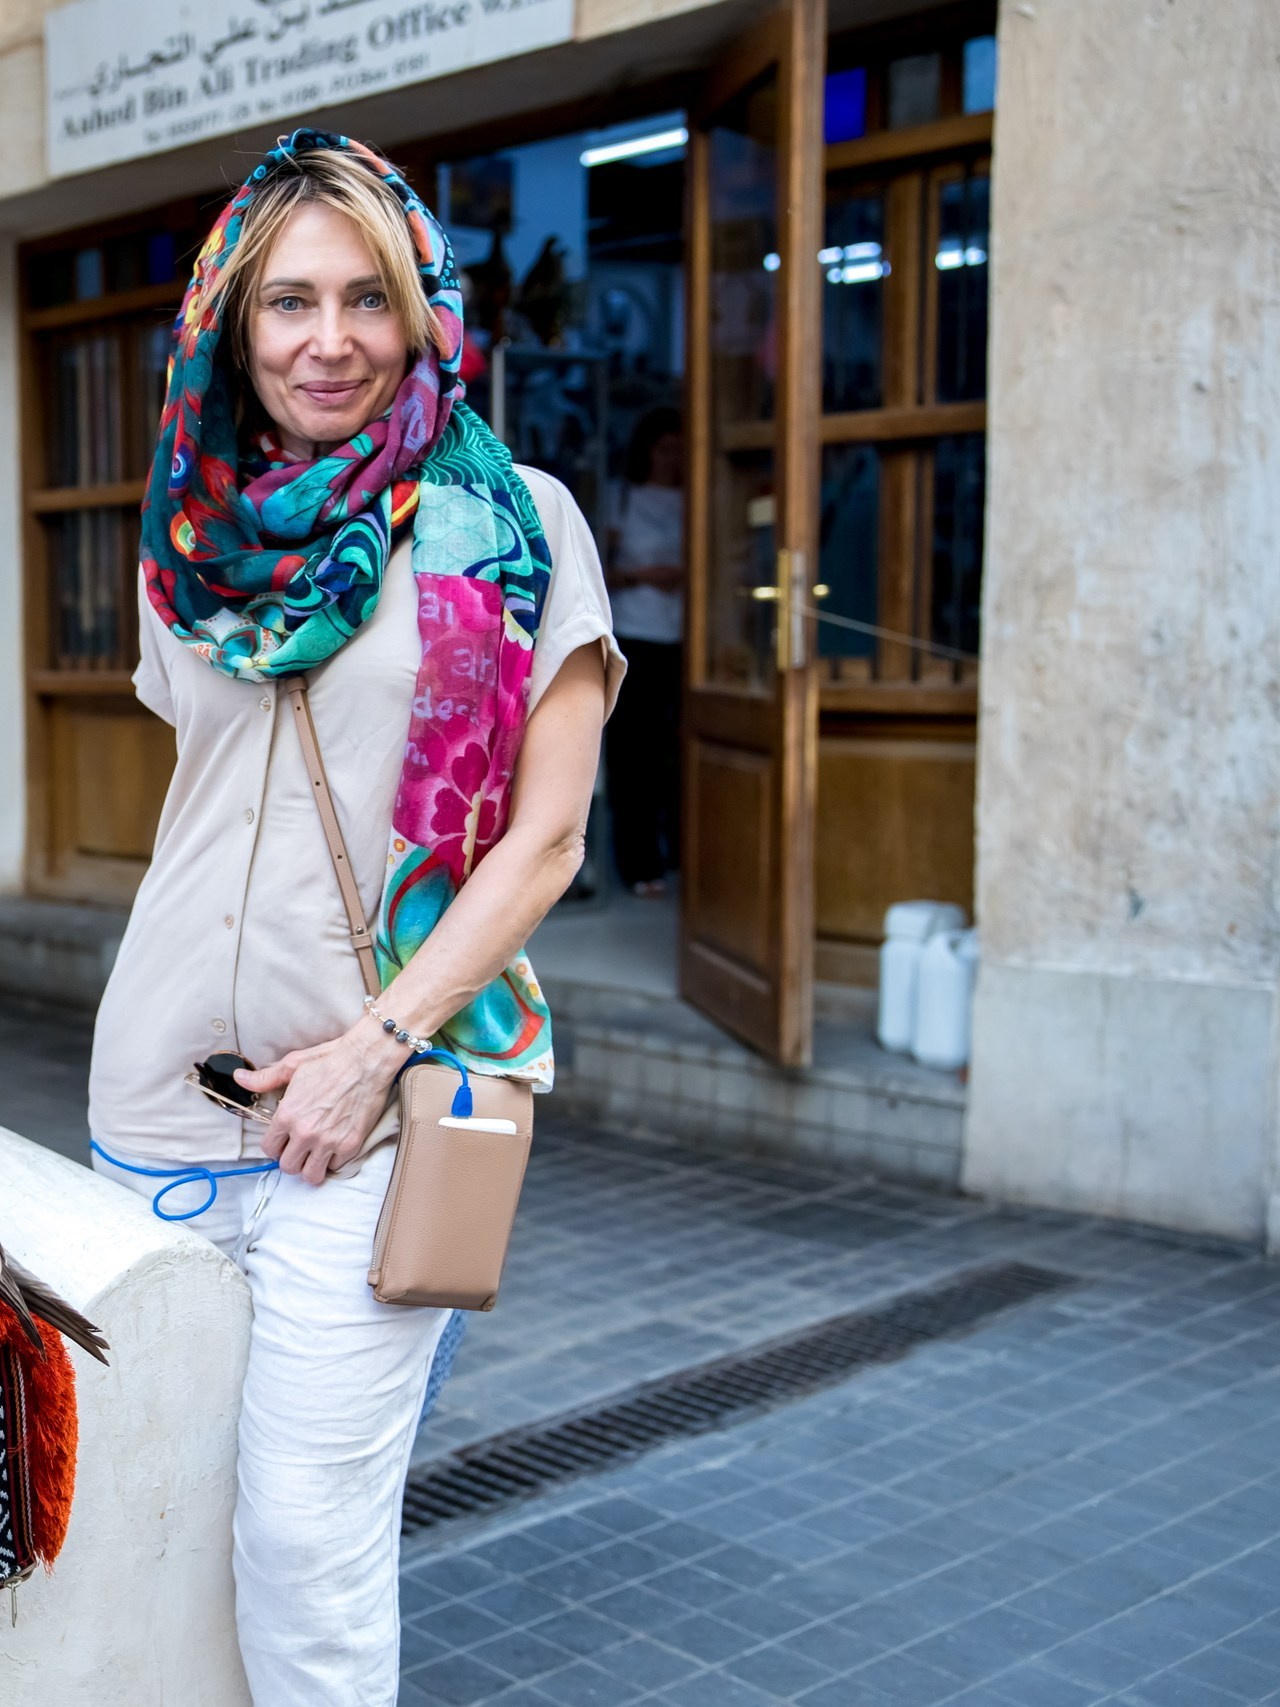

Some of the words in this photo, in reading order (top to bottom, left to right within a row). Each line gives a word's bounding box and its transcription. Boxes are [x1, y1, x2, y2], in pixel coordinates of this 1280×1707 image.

[142, 85, 188, 118] Bin
[193, 62, 235, 97] Ali
[244, 32, 359, 87] Trading
[367, 1, 471, 51] Office
